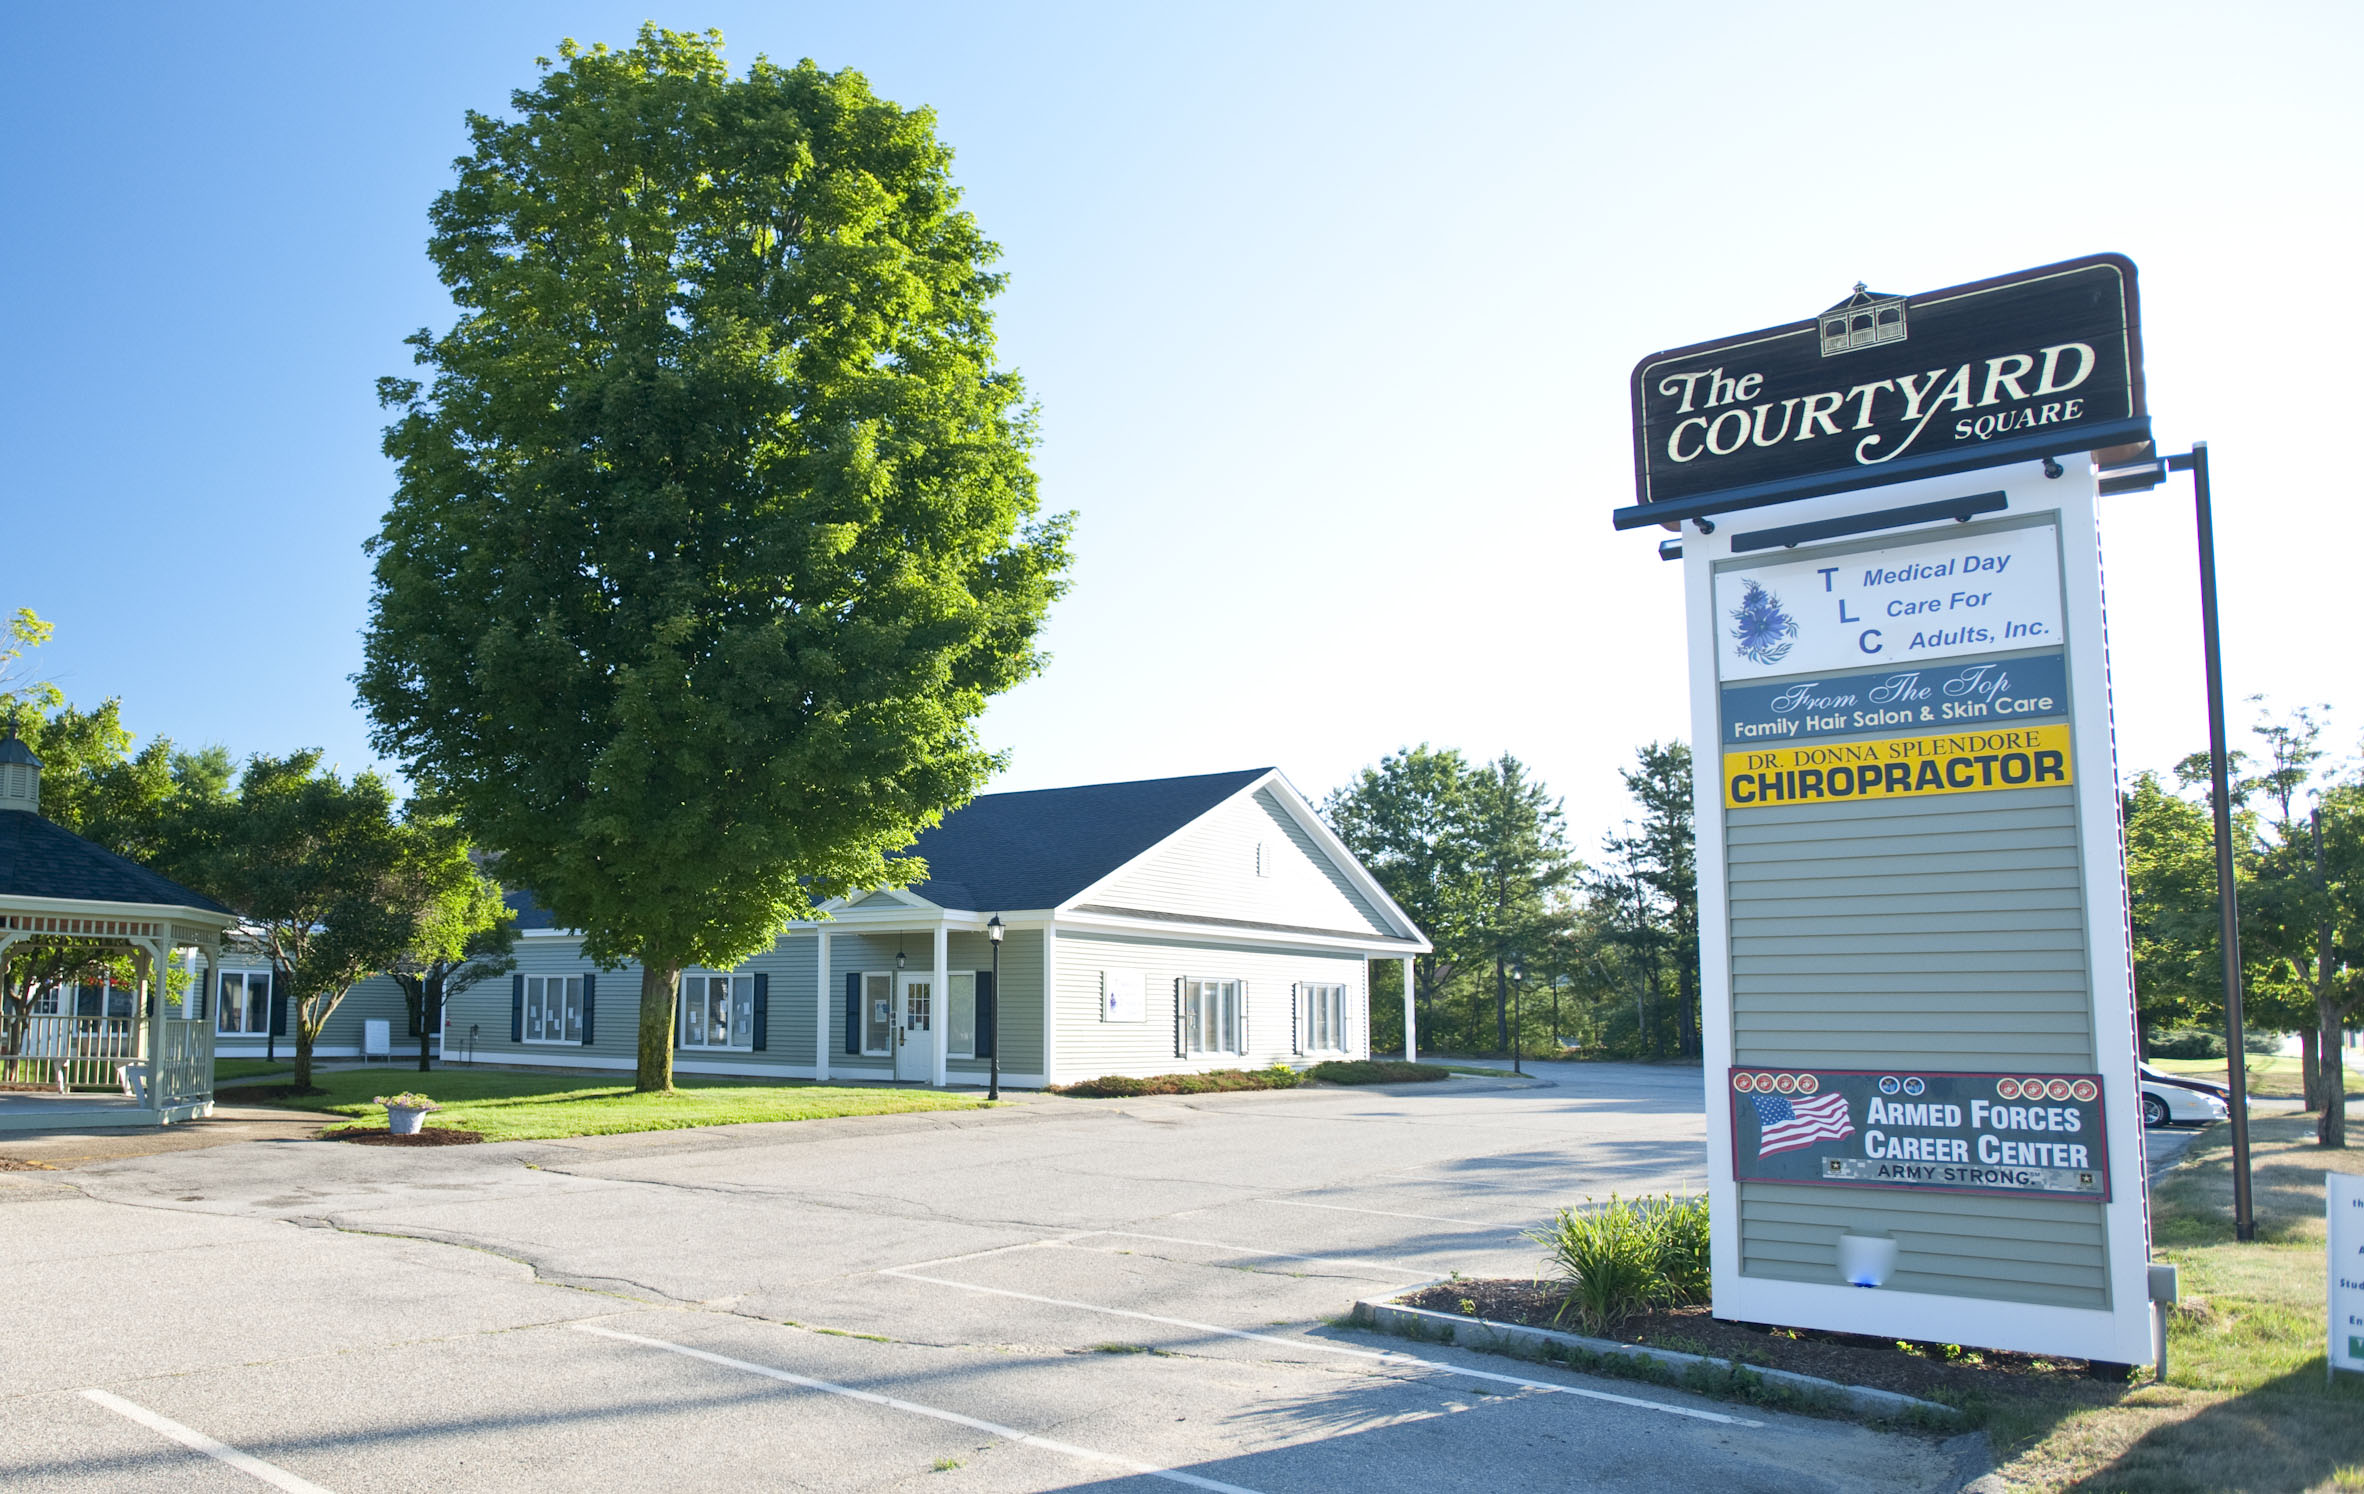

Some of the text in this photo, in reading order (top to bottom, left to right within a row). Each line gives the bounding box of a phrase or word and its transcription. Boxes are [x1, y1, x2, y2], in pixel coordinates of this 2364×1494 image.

[1658, 367, 1764, 414] The
[1667, 342, 2096, 465] COURTYARD
[1954, 398, 2085, 440] SQUARE
[1817, 554, 2012, 592] T Medical Day
[1838, 591, 1992, 623] L Care For
[1858, 620, 2050, 654] C Adults, Inc.
[1770, 663, 2011, 713] From The Top
[1734, 697, 2053, 738] Family Hair Salon & Skin Care
[1747, 730, 2041, 771] DR. DONNA SPLENDORE
[1731, 749, 2065, 804] CHIROPRACTOR
[1878, 1164, 1937, 1179] ARMY
